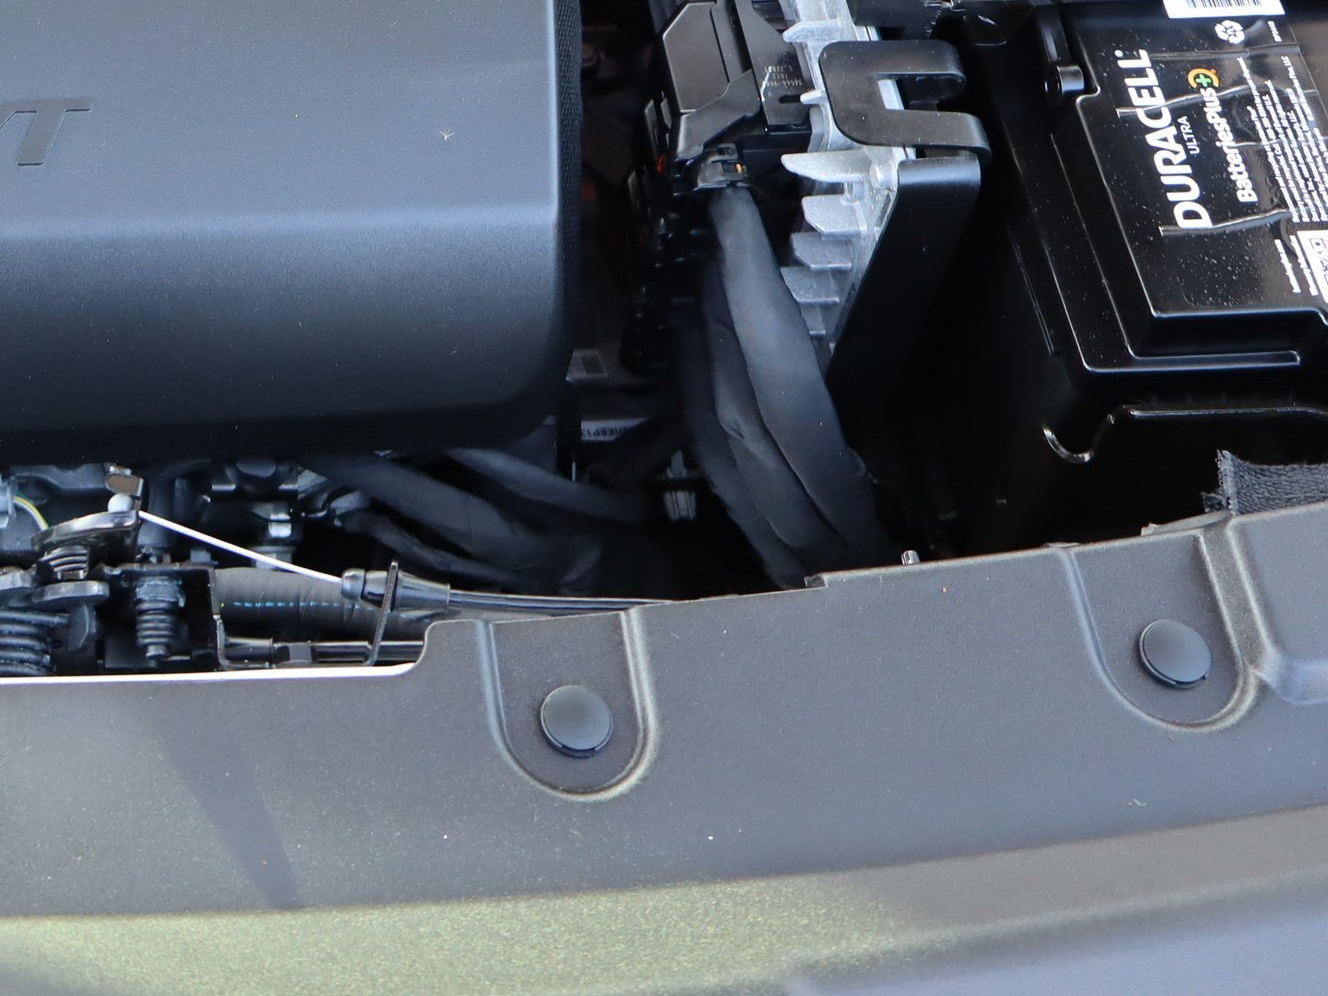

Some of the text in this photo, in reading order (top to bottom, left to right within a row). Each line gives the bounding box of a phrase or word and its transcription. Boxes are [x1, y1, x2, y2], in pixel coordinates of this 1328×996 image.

[1118, 49, 1212, 229] DURACELL
[1177, 115, 1201, 156] ULTRA
[1199, 87, 1258, 203] BatteriesPlus
